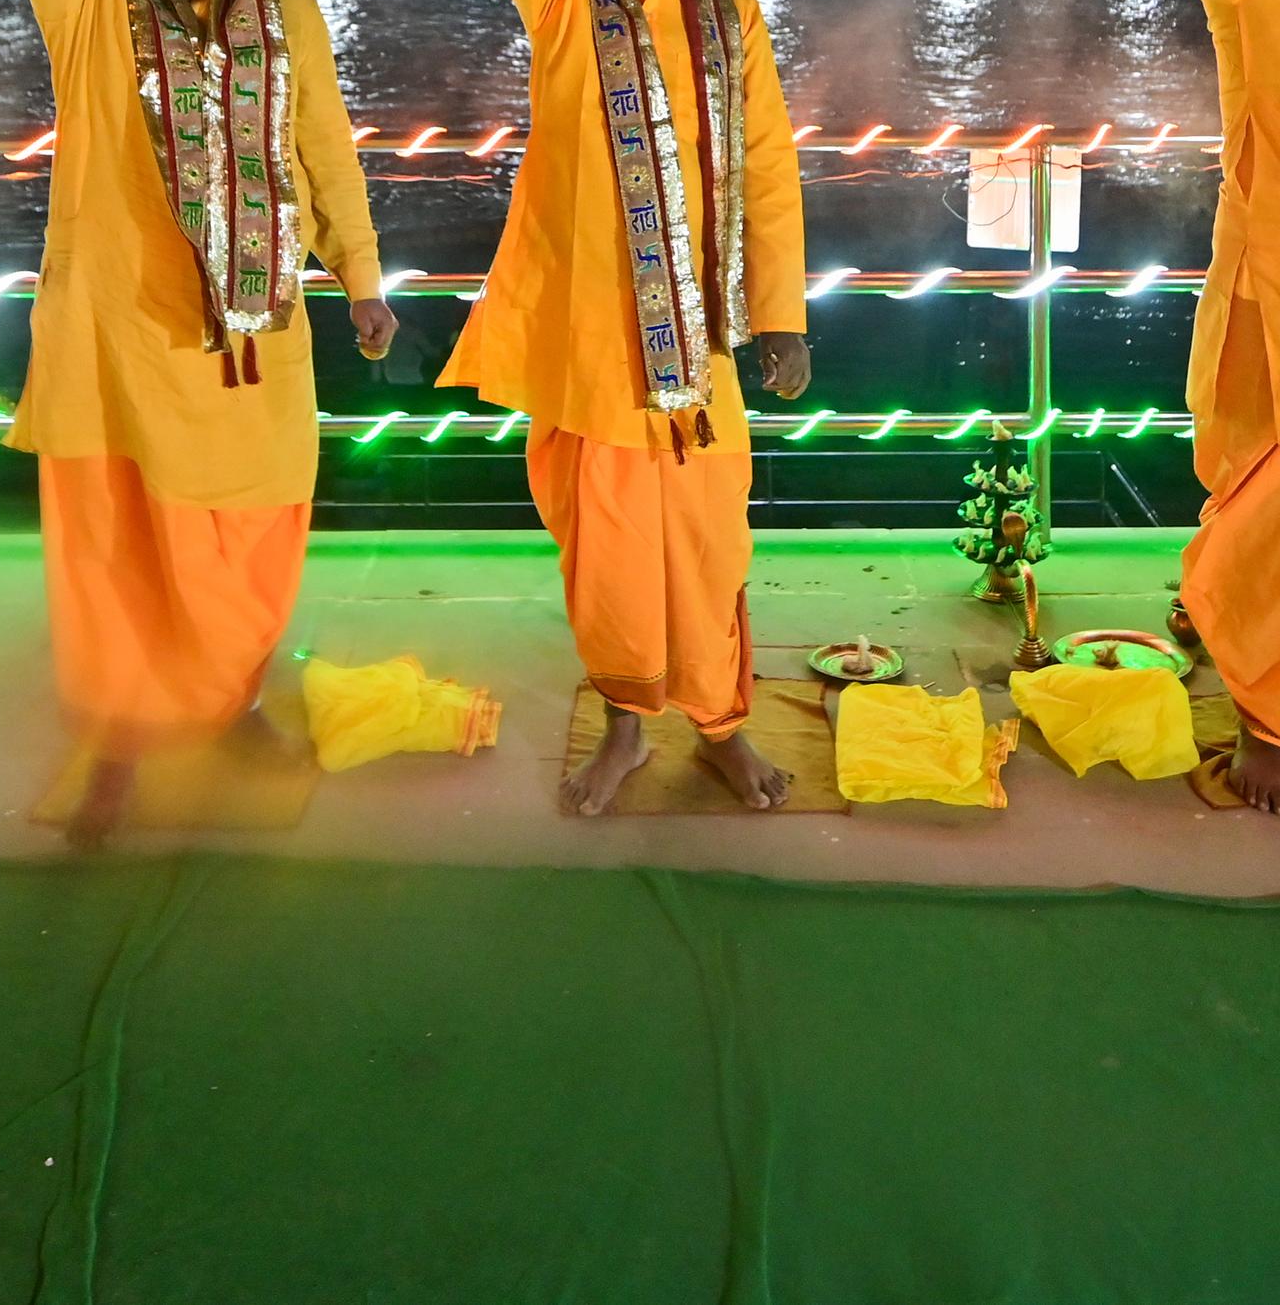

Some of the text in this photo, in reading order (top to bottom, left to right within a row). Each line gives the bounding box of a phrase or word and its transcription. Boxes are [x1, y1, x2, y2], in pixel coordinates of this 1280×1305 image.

[610, 83, 639, 116] राधे
[629, 200, 658, 233] राधे
[646, 318, 675, 352] राधे
